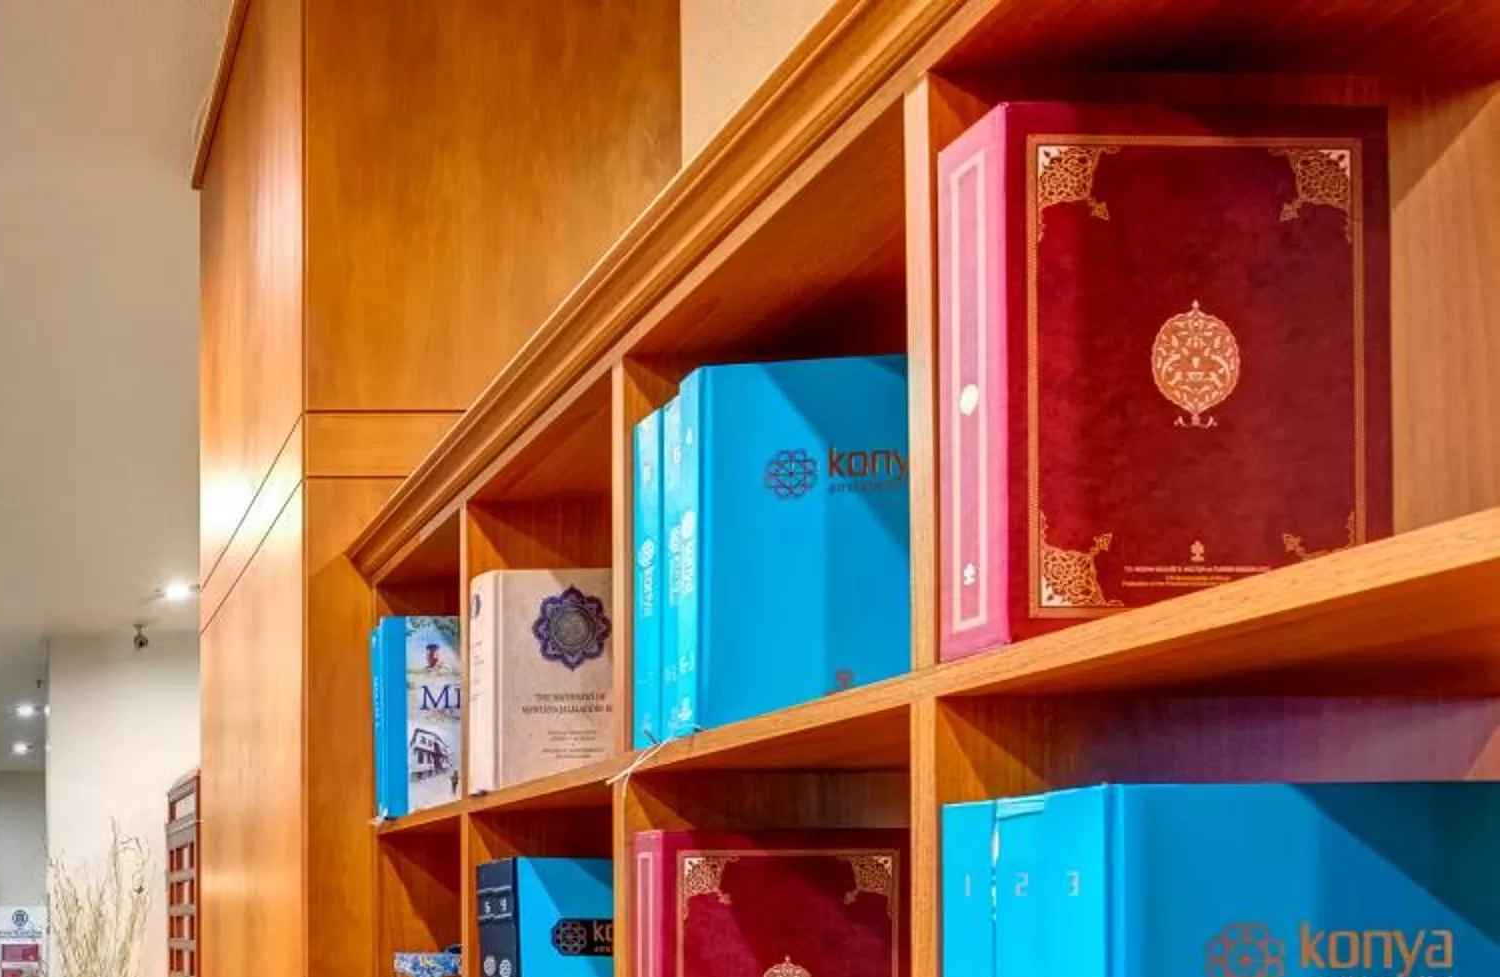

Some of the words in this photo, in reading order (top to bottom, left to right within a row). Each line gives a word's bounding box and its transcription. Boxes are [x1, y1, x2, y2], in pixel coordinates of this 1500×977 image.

[964, 872, 972, 897] 1
[1014, 871, 1030, 897] 2
[1066, 870, 1080, 897] 3
[1300, 921, 1454, 977] konya
